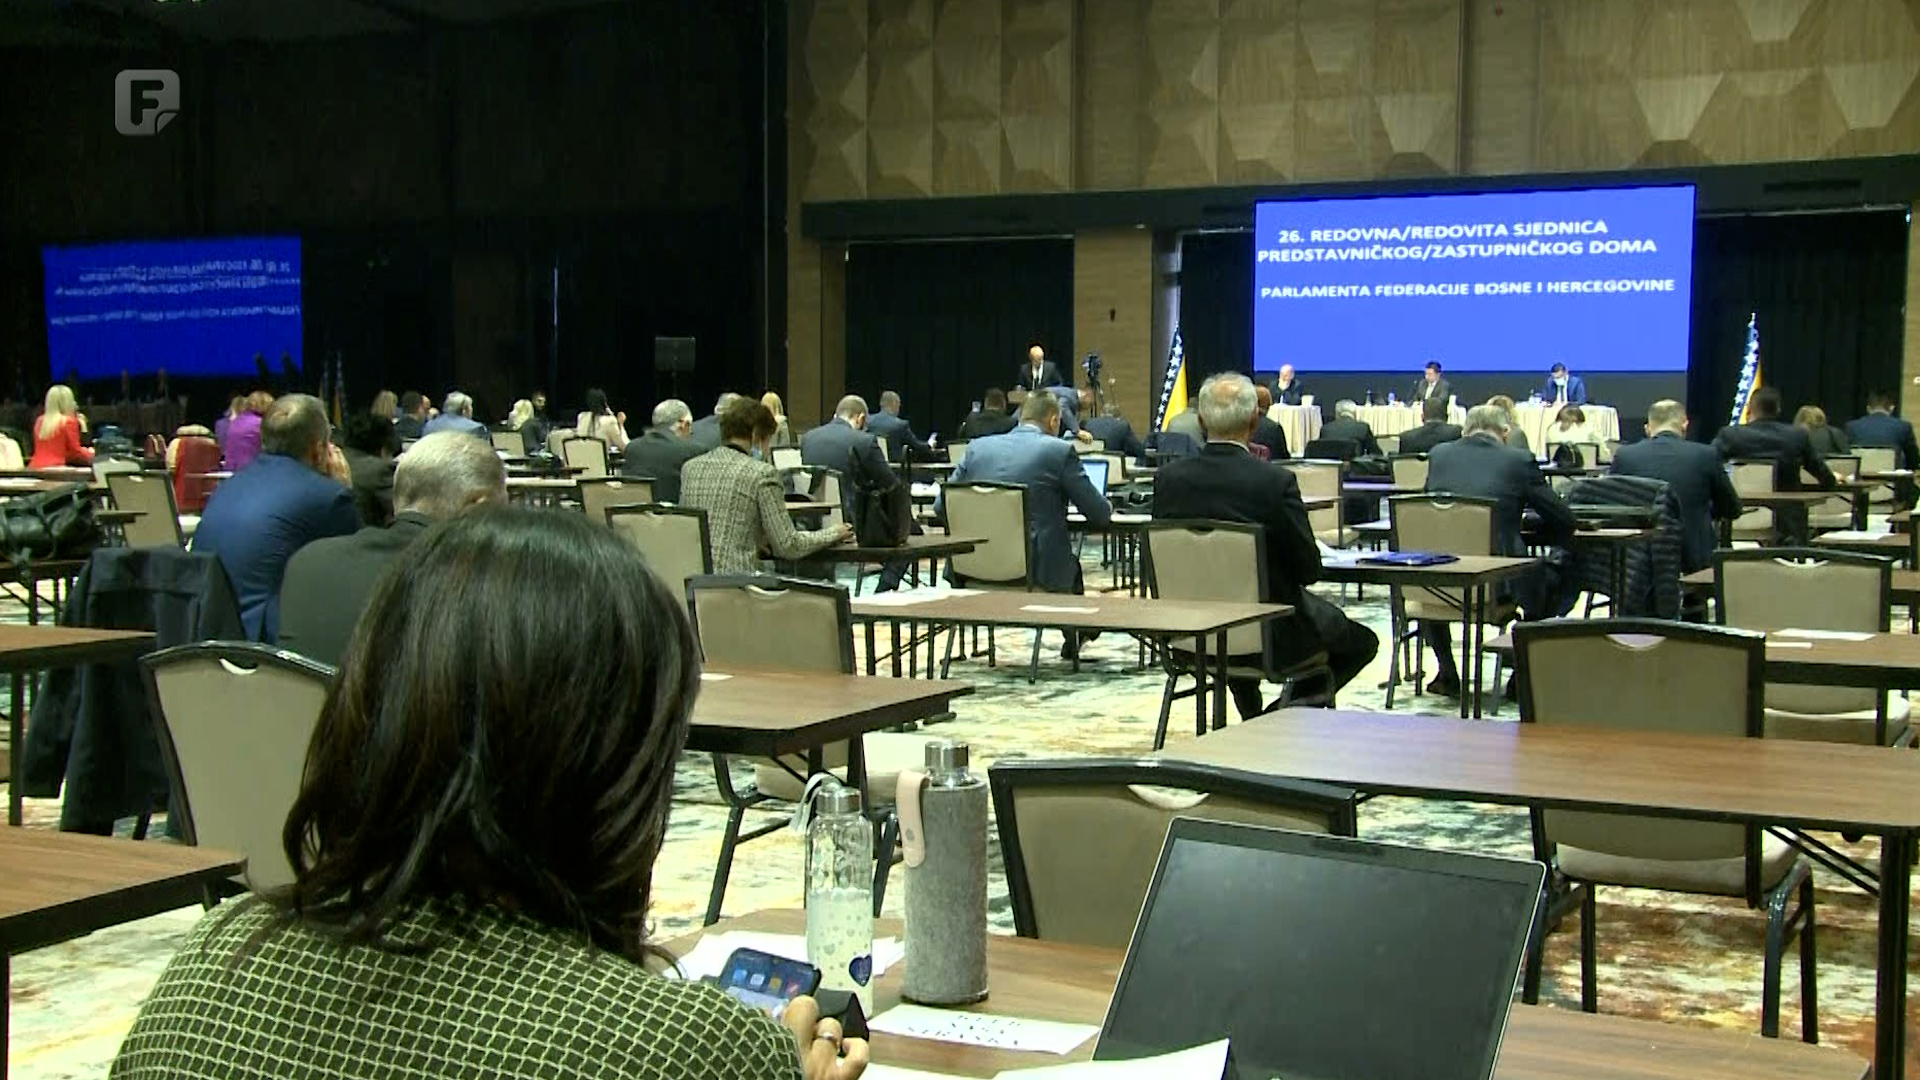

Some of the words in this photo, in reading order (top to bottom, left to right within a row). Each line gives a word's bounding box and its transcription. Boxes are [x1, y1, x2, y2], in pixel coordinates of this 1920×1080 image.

[1278, 230, 1305, 244] 26.
[1310, 223, 1509, 243] REDOVNA/REDOVITA
[1513, 219, 1609, 236] SJEDNICA
[1257, 239, 1584, 263] PREDSTAVNIČKOG/ZASTUPNIČKOG
[1588, 238, 1657, 254] DOMA
[1260, 284, 1371, 298] PARLAMENTA
[1374, 283, 1470, 297] FEDERACIJE
[1473, 281, 1532, 295] BOSNE
[1537, 281, 1543, 293] I
[1547, 279, 1676, 294] HERCEGOVINE
